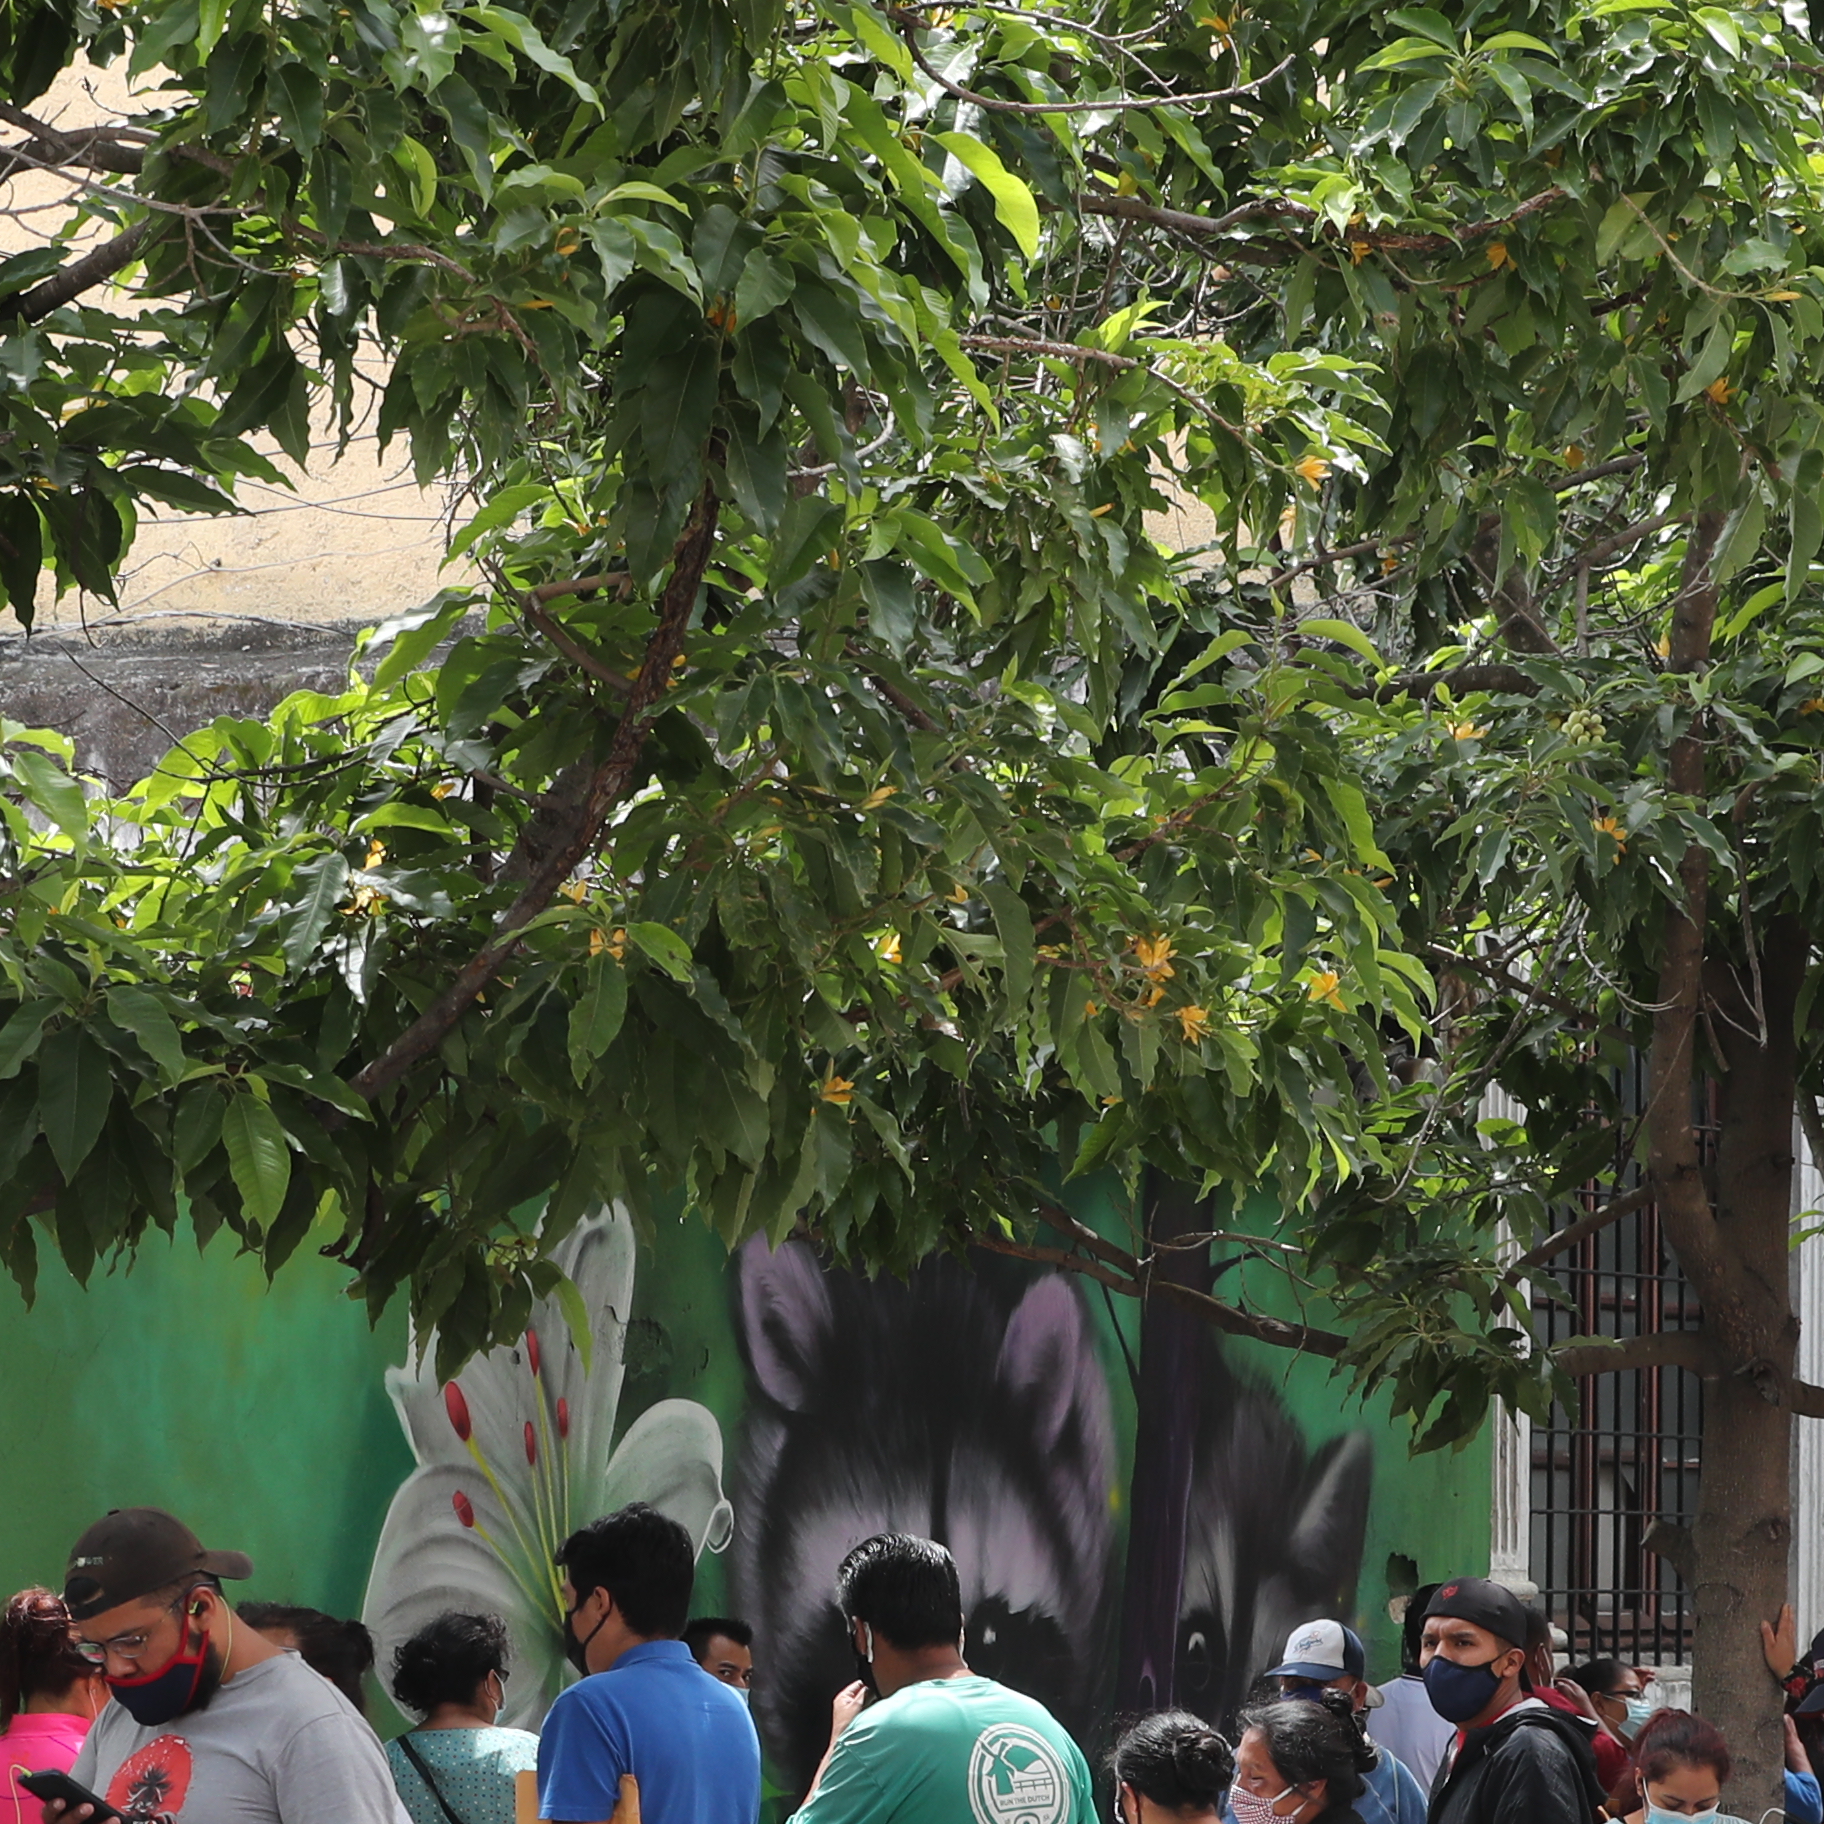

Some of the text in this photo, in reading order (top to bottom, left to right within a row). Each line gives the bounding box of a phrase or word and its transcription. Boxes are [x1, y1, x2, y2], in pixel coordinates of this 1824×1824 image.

[1000, 1794, 1050, 1806] RUN THE DUTCH
